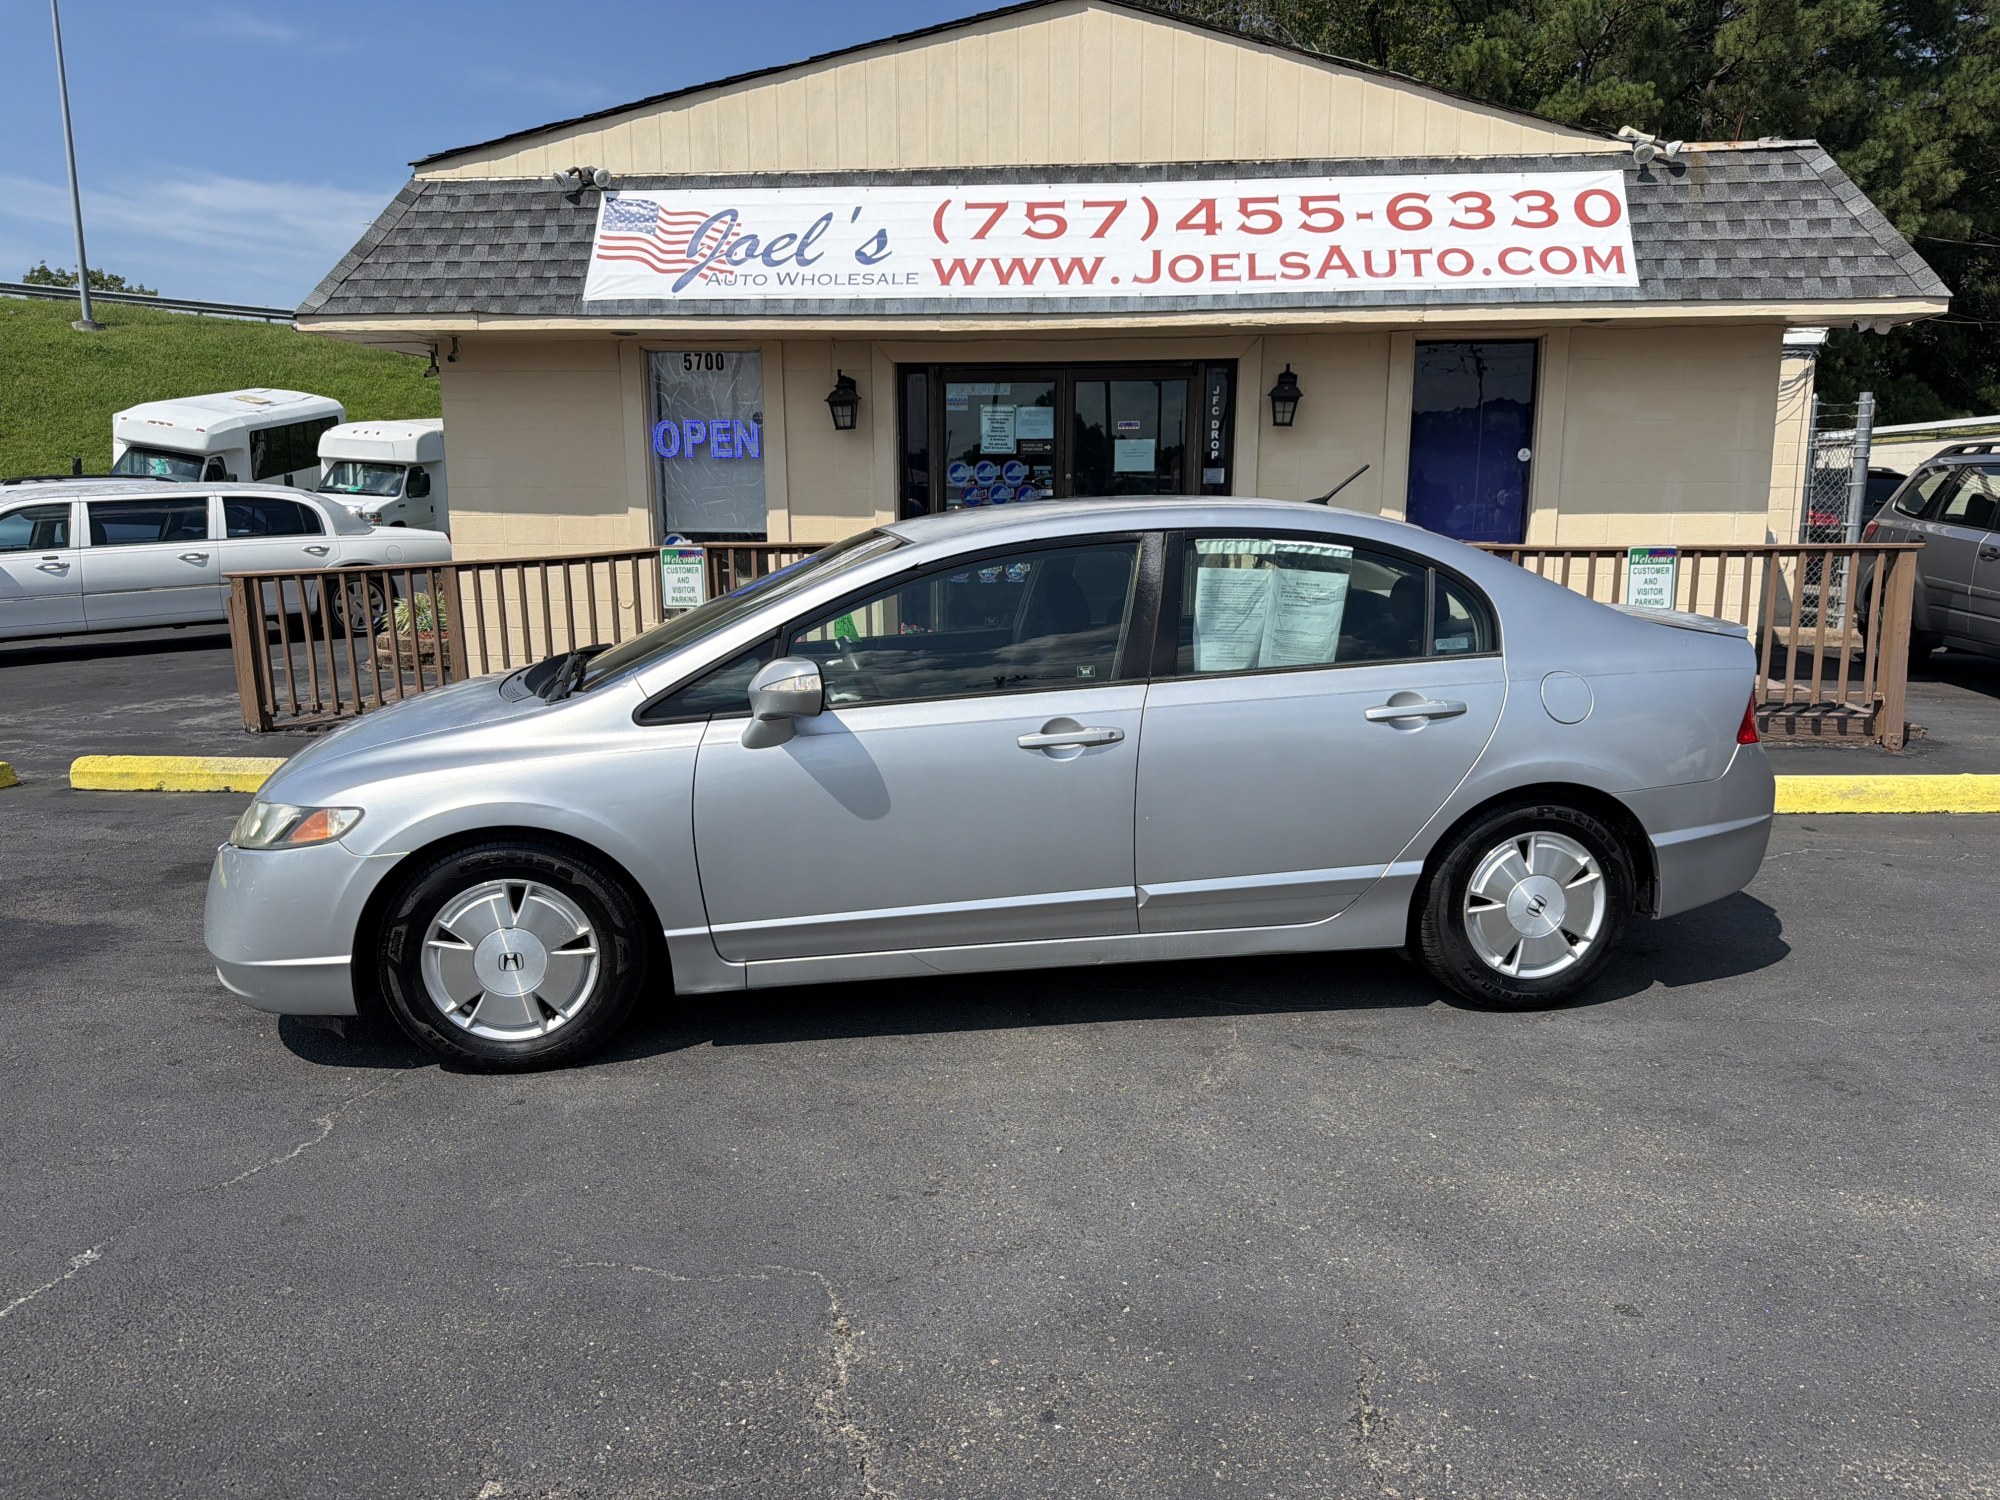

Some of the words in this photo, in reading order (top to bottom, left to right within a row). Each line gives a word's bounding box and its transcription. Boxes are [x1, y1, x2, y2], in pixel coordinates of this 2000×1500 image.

[931, 188, 1622, 245] (757)455-6330
[671, 205, 893, 293] Joel's
[683, 352, 725, 371] 5700
[655, 419, 760, 459] OPEN
[1210, 420, 1220, 460] DROP
[664, 554, 701, 564] Welcome
[1631, 554, 1672, 564] Welcome
[666, 566, 700, 574] CUSTOMER
[1633, 567, 1670, 575] CUSTOMER
[1643, 577, 1658, 585] AND
[672, 586, 696, 594] VISITOR
[1637, 587, 1664, 596] VISITOR
[671, 596, 698, 604] PARKING
[1635, 598, 1665, 606] PARKING
